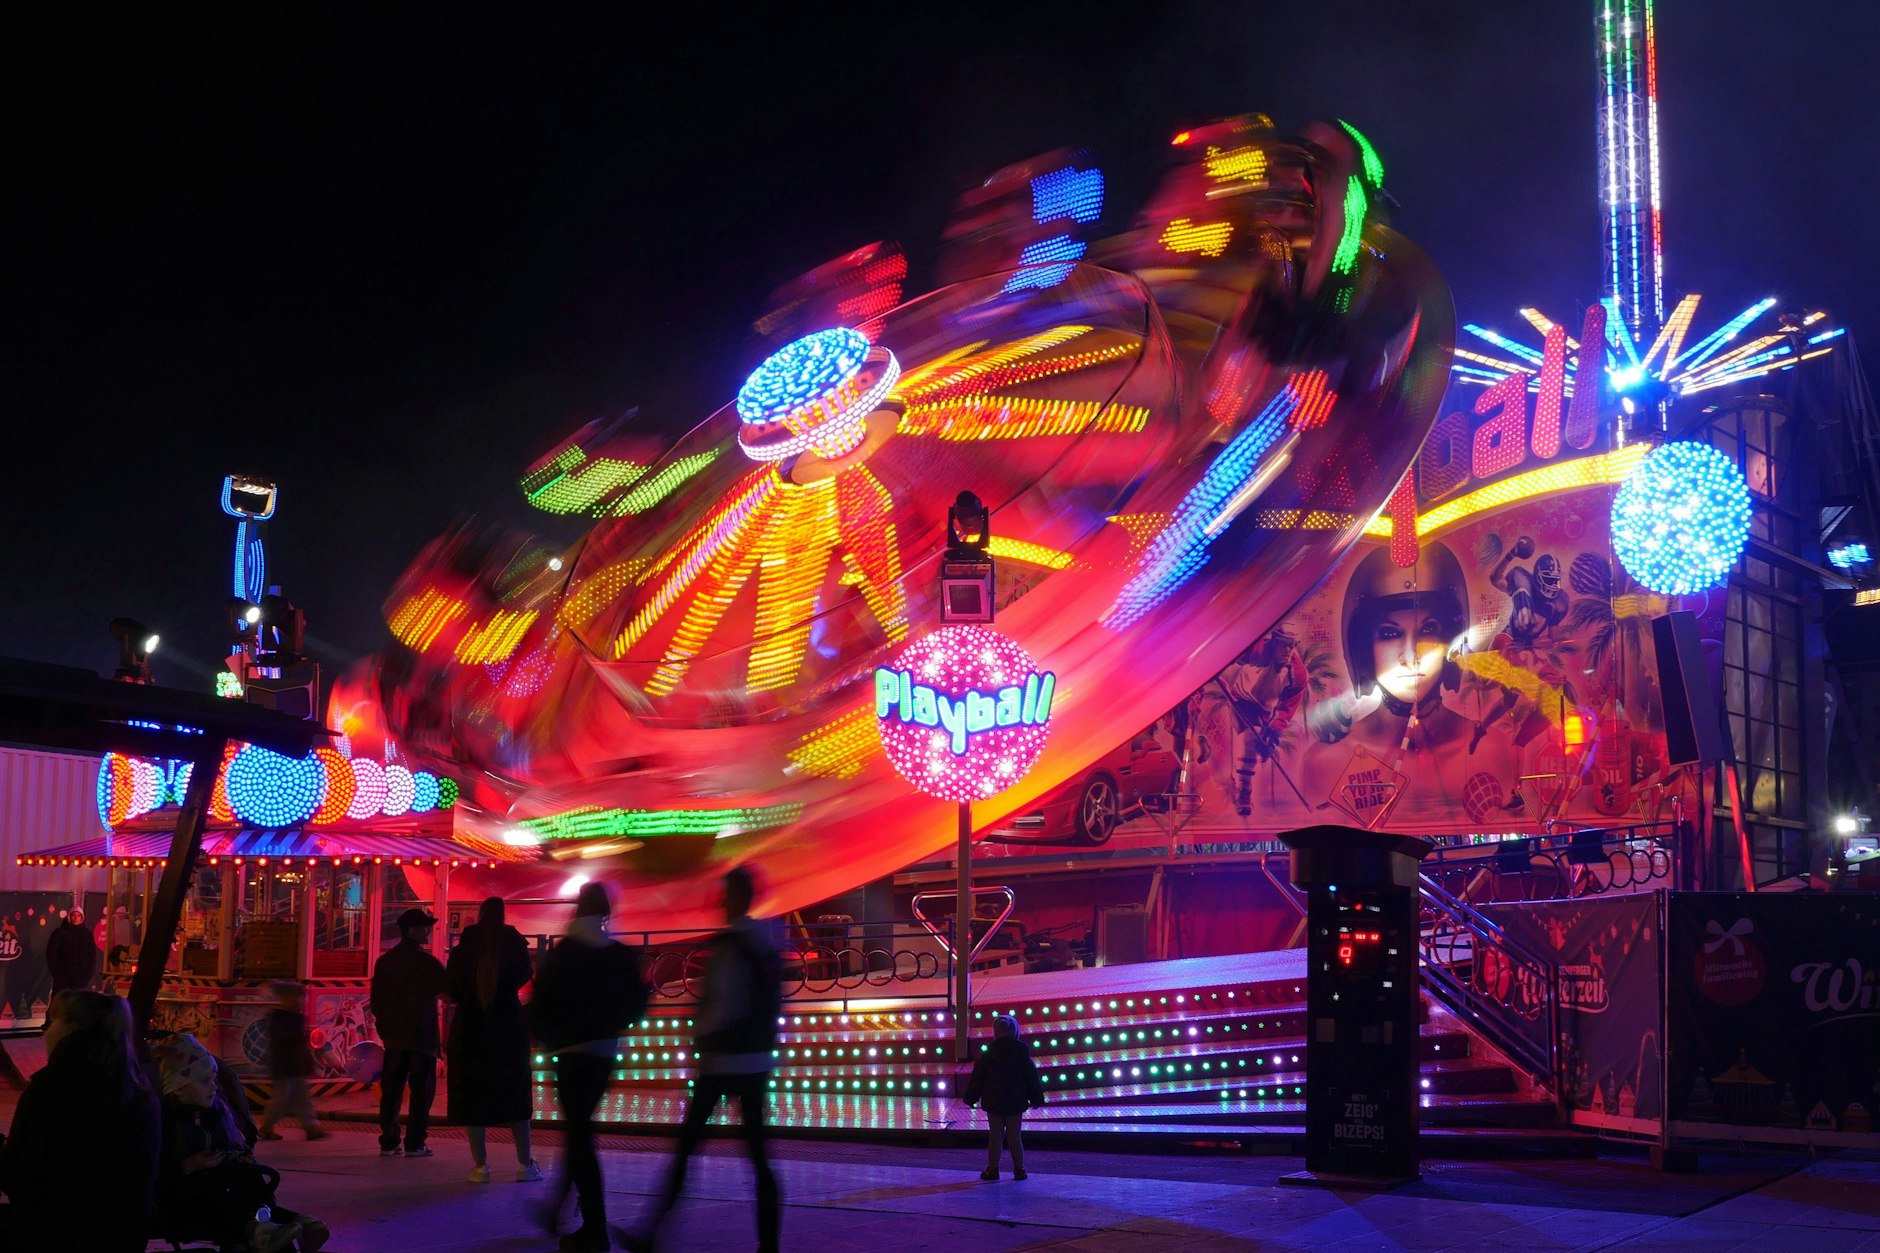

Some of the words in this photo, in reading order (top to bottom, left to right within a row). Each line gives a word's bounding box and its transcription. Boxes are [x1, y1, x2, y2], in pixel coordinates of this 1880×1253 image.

[874, 667, 1056, 756] Playball
[1348, 769, 1380, 785] PIMP
[1355, 793, 1385, 809] RIDE
[1334, 1123, 1384, 1140] BIZEPS!
